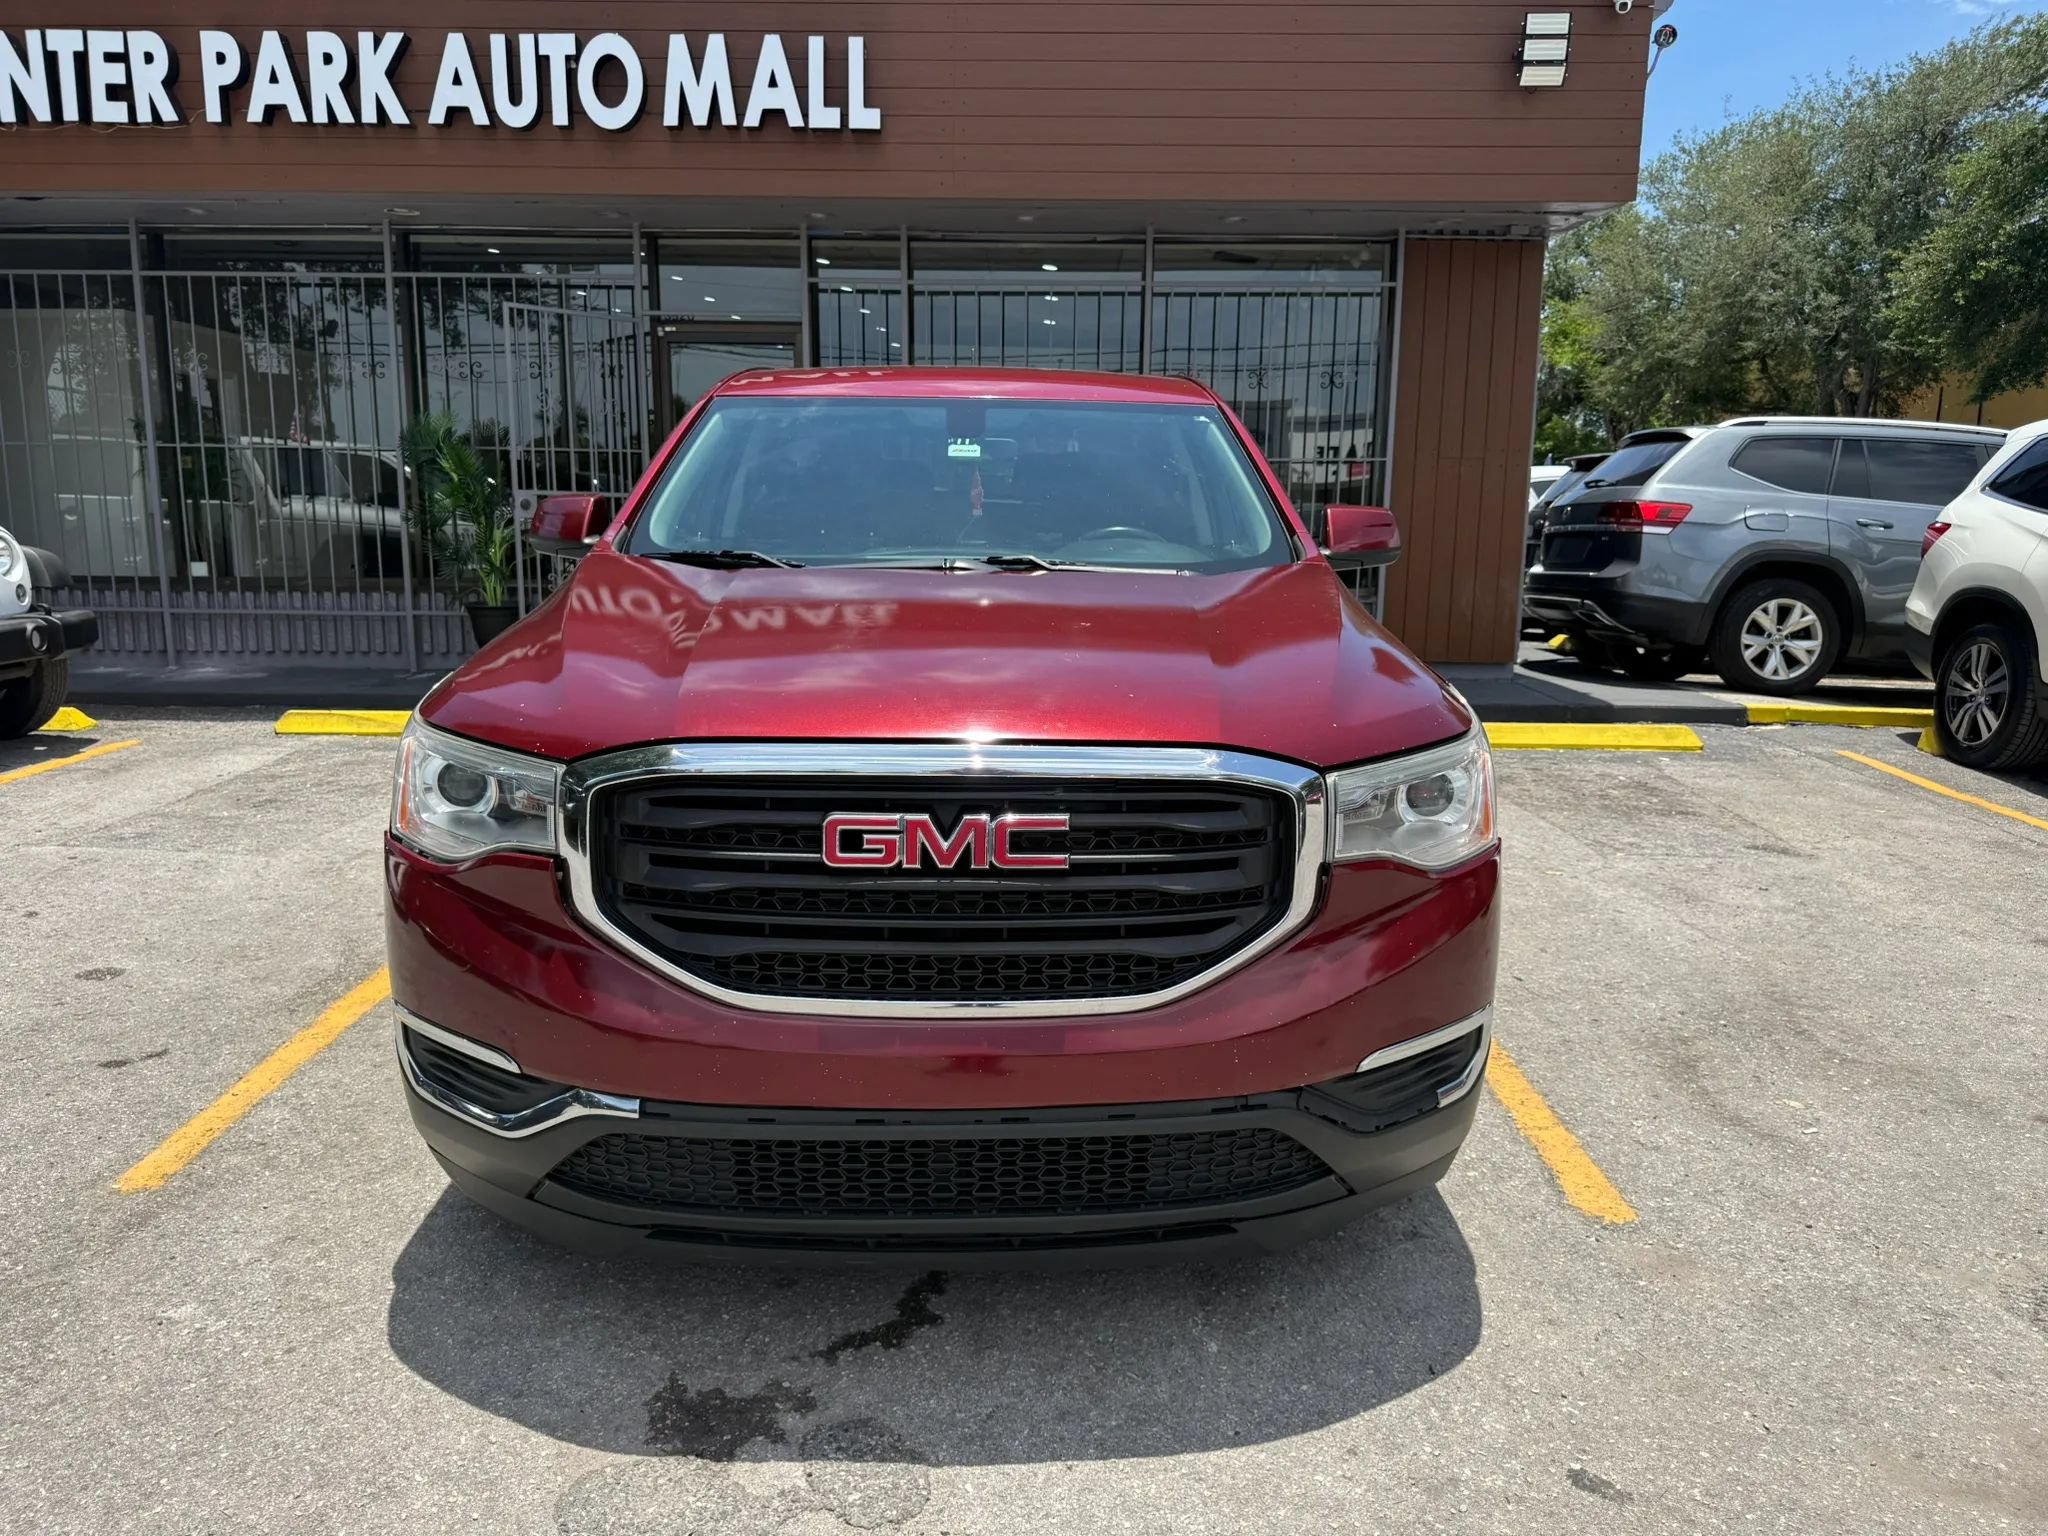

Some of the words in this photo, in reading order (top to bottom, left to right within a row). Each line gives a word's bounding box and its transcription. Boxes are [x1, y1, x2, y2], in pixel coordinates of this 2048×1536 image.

[0, 28, 180, 123] NTER
[199, 30, 410, 124] PARK
[428, 32, 645, 130] AUTO
[663, 33, 881, 130] MALL
[822, 812, 1070, 868] GMC
